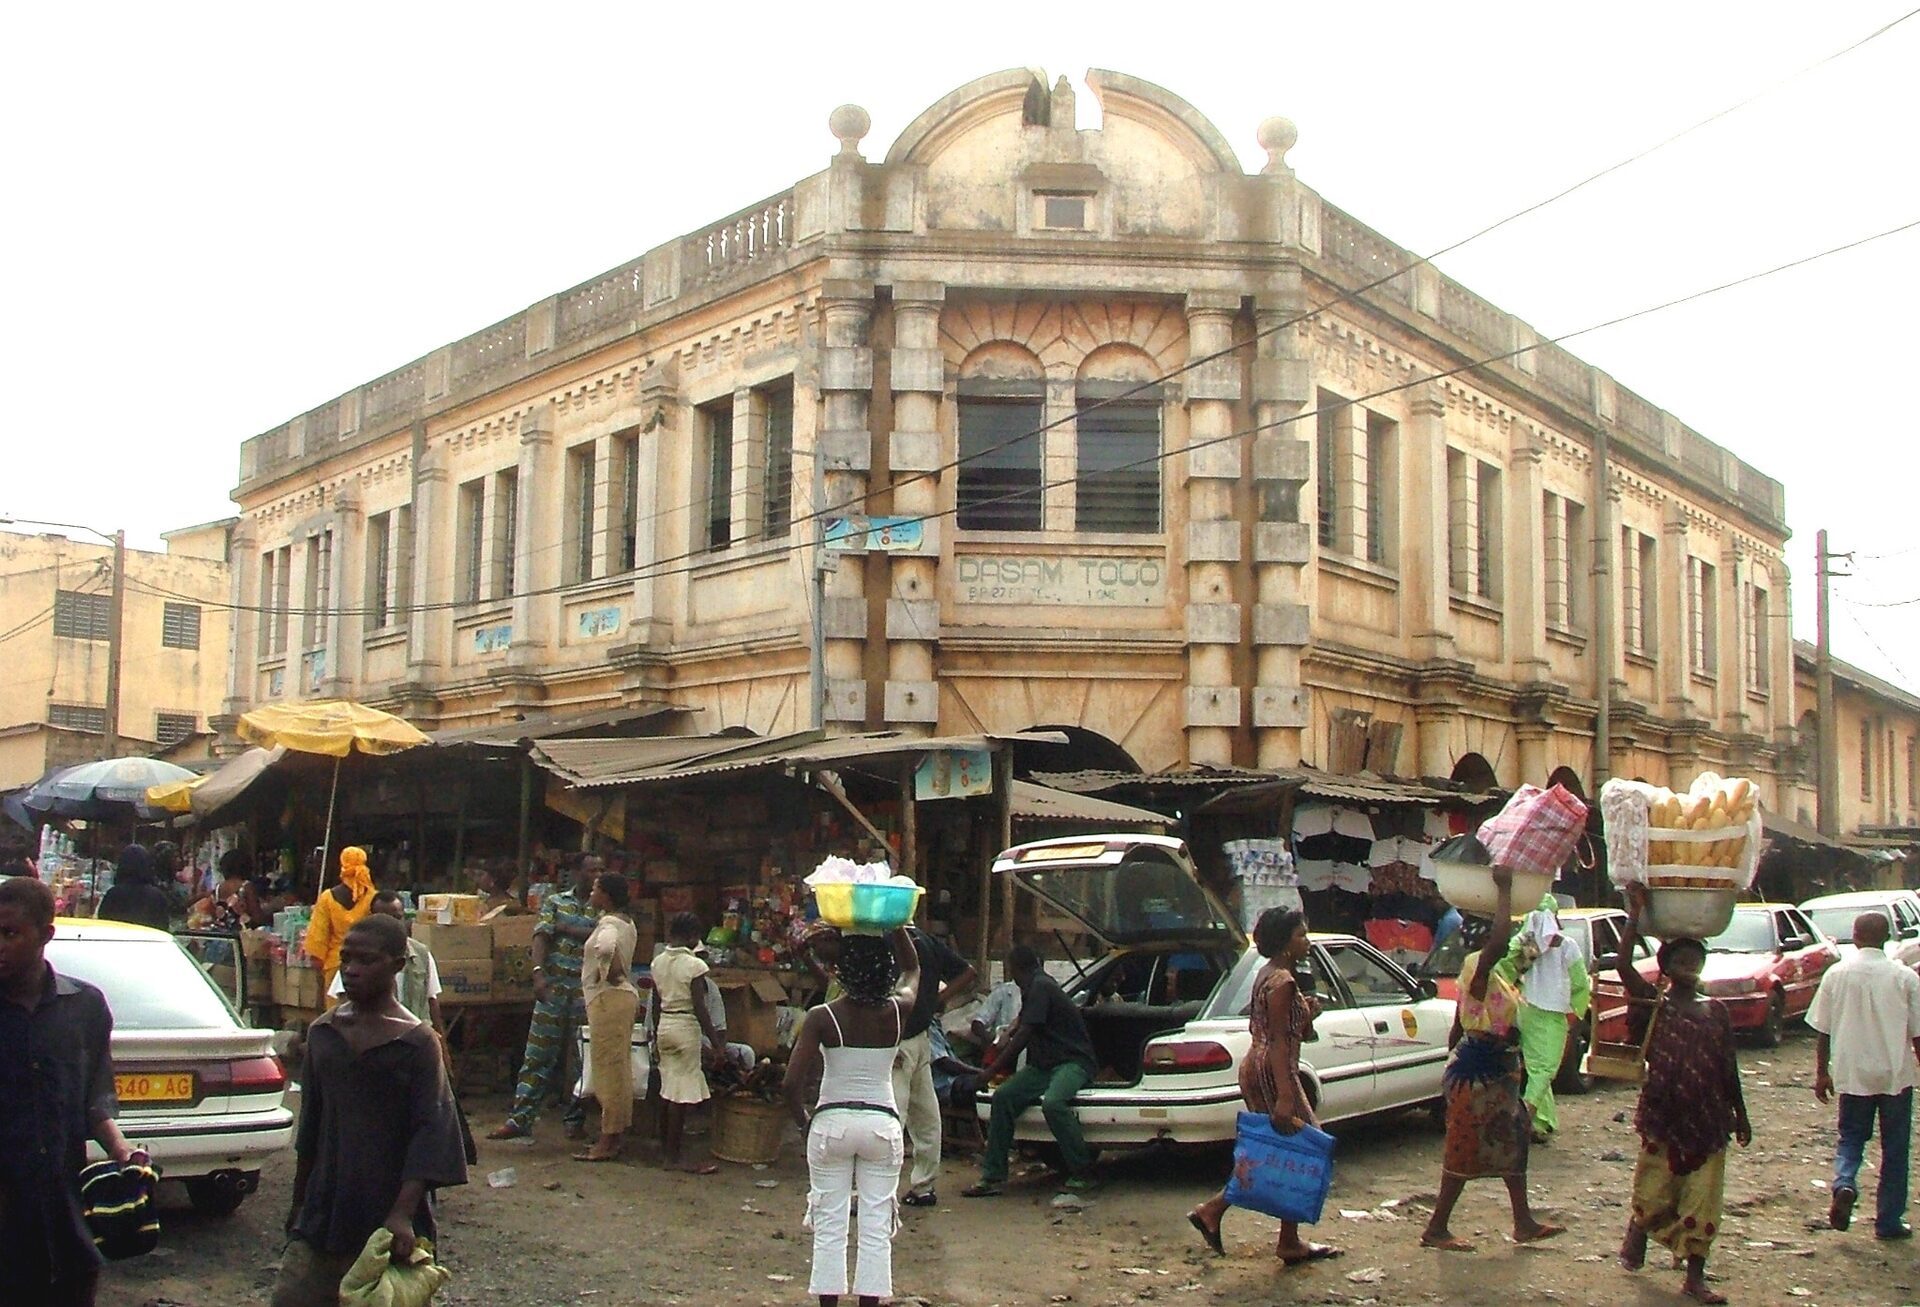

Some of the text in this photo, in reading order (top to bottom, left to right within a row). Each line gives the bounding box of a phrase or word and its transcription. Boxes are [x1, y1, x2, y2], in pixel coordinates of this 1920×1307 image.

[959, 557, 1160, 587] DASAM TOGO
[164, 1077, 189, 1096] AG
